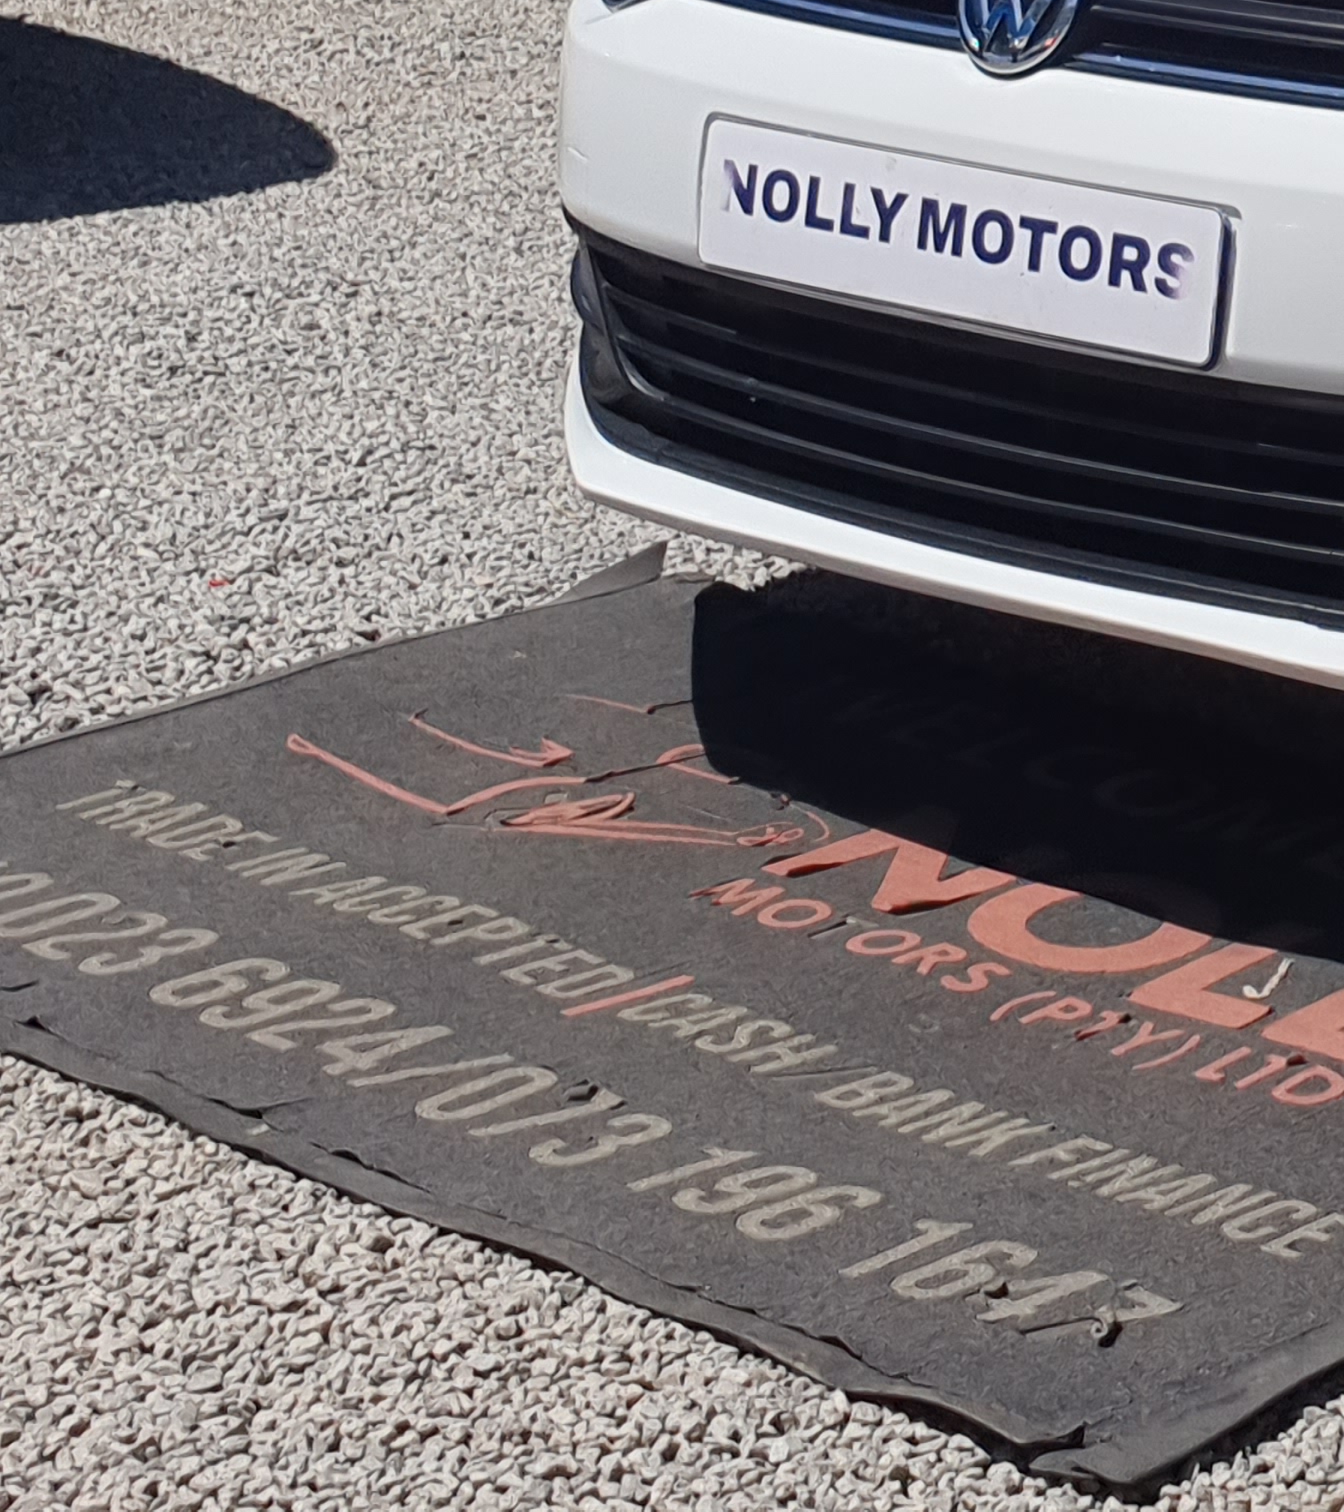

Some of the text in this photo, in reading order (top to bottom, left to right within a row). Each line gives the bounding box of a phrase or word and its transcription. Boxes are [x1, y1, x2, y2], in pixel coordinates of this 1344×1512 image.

[722, 158, 1196, 300] NOLLY MOTORS
[55, 778, 279, 862] TRADE
[224, 847, 348, 887] IN
[688, 877, 1013, 994] MOTORS
[626, 1144, 884, 1242] 196
